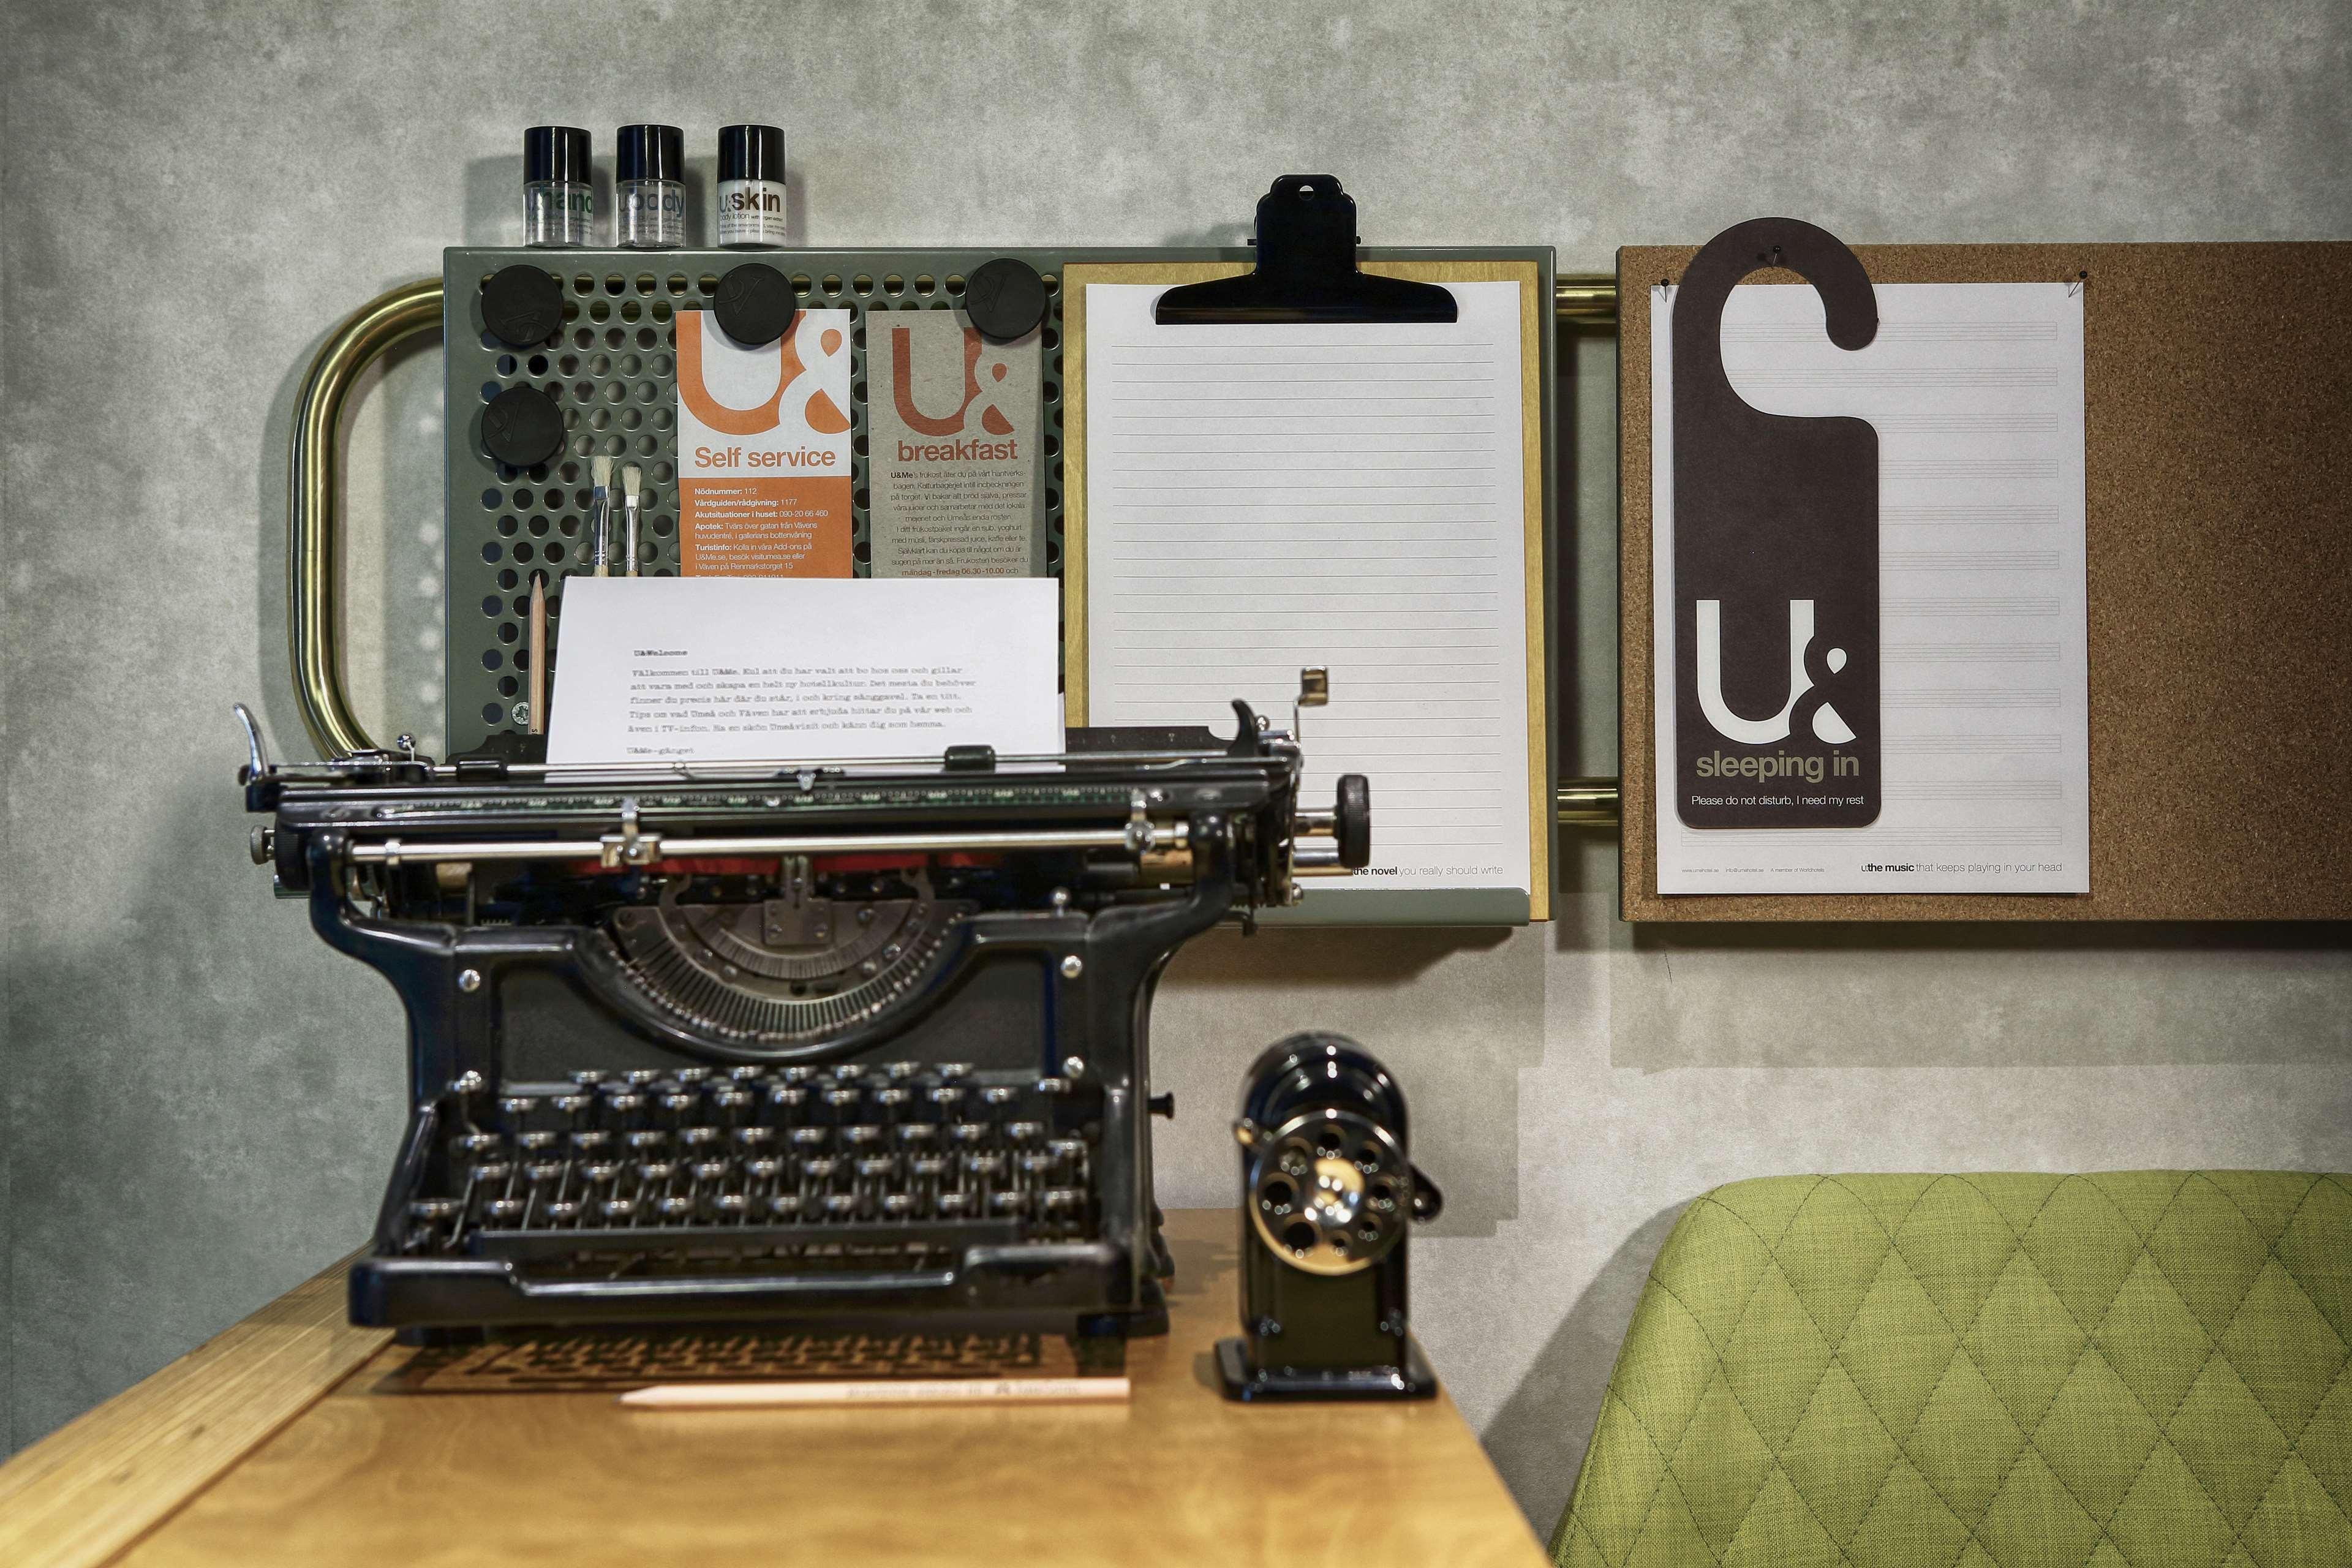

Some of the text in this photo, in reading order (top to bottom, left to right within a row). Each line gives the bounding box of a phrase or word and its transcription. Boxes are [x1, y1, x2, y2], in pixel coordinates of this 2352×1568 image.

[695, 446, 835, 468] Self service
[898, 439, 1017, 461] breakfast
[1696, 750, 1859, 783] sleeping in
[1692, 796, 1723, 805] Please
[1725, 796, 1738, 805] do
[1741, 796, 1756, 805] not
[1758, 796, 1794, 806] disturb,
[1802, 796, 1826, 804] need
[1828, 797, 1843, 806] my
[1846, 796, 1864, 804] rest
[1371, 866, 1397, 875] novel
[1399, 867, 1416, 877] you
[1419, 866, 1443, 877] really
[1446, 865, 1477, 875] should
[1480, 865, 1503, 875] write
[1885, 863, 1914, 872] music
[1916, 863, 1933, 872] that
[1936, 863, 1965, 873] keeps
[1968, 863, 2000, 874] playing
[2004, 863, 2011, 872] in
[2015, 864, 2035, 873] your
[2038, 863, 2062, 872] head
